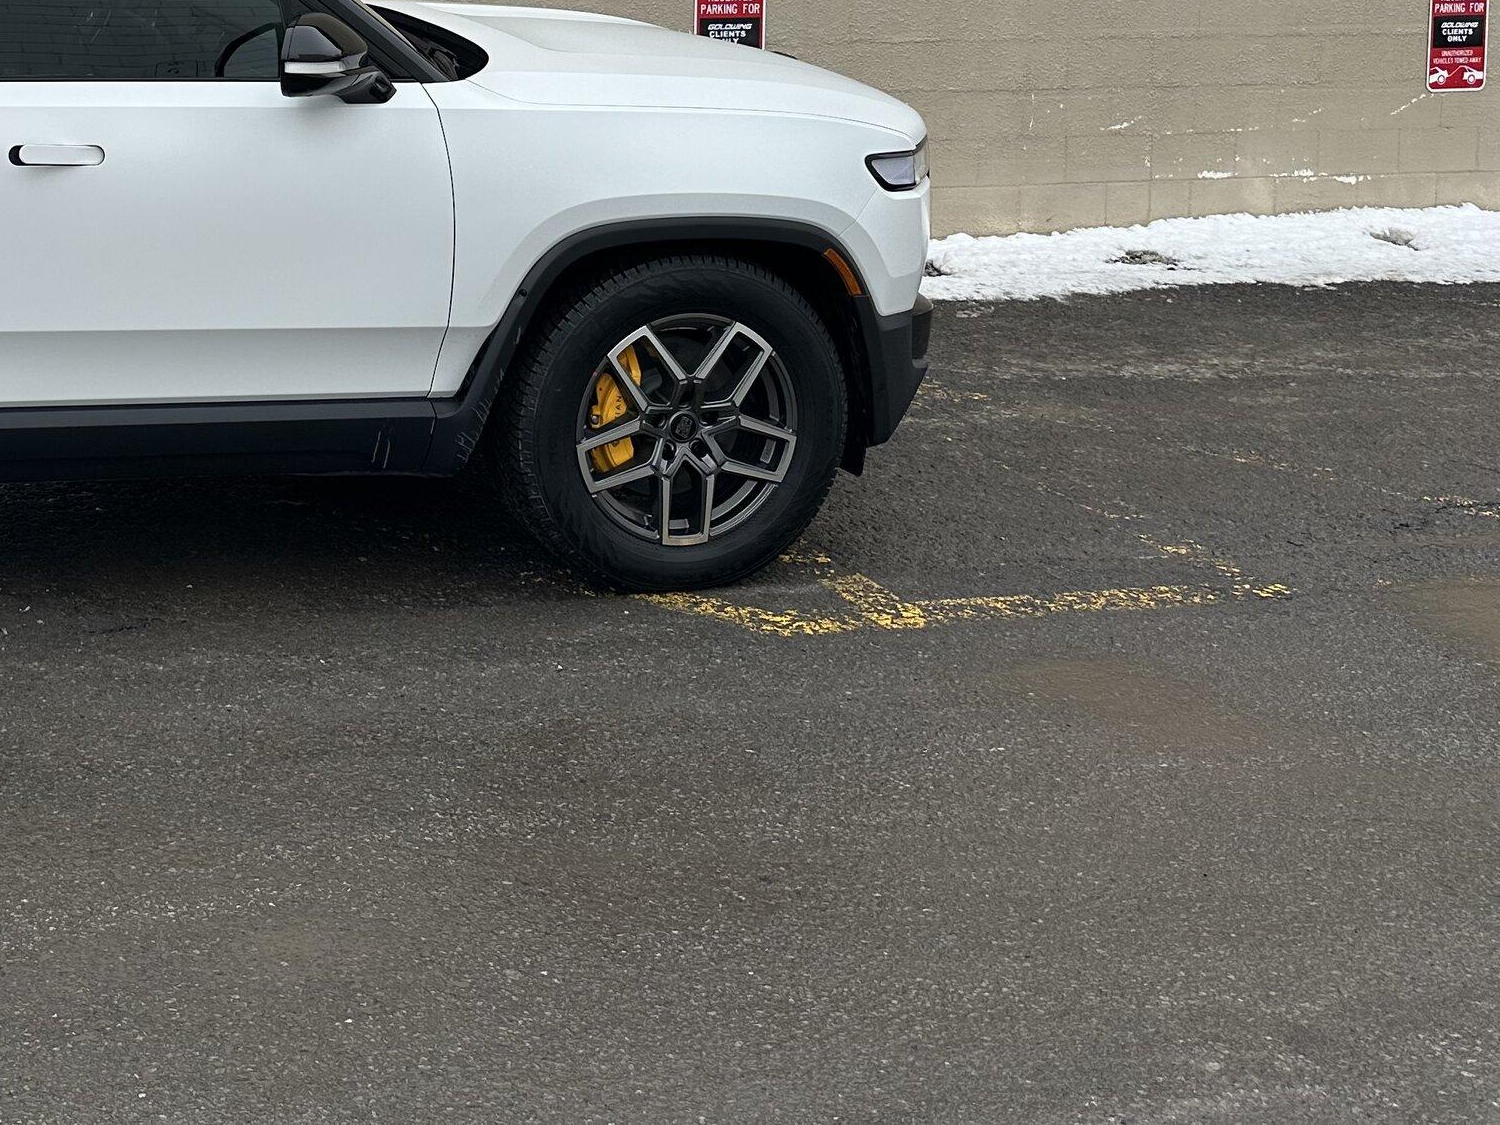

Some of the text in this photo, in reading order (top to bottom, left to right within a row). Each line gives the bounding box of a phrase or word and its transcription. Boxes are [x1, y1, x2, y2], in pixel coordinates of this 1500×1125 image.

[700, 3, 760, 14] PARKING FOR
[1435, 3, 1485, 13] PARKING FOR
